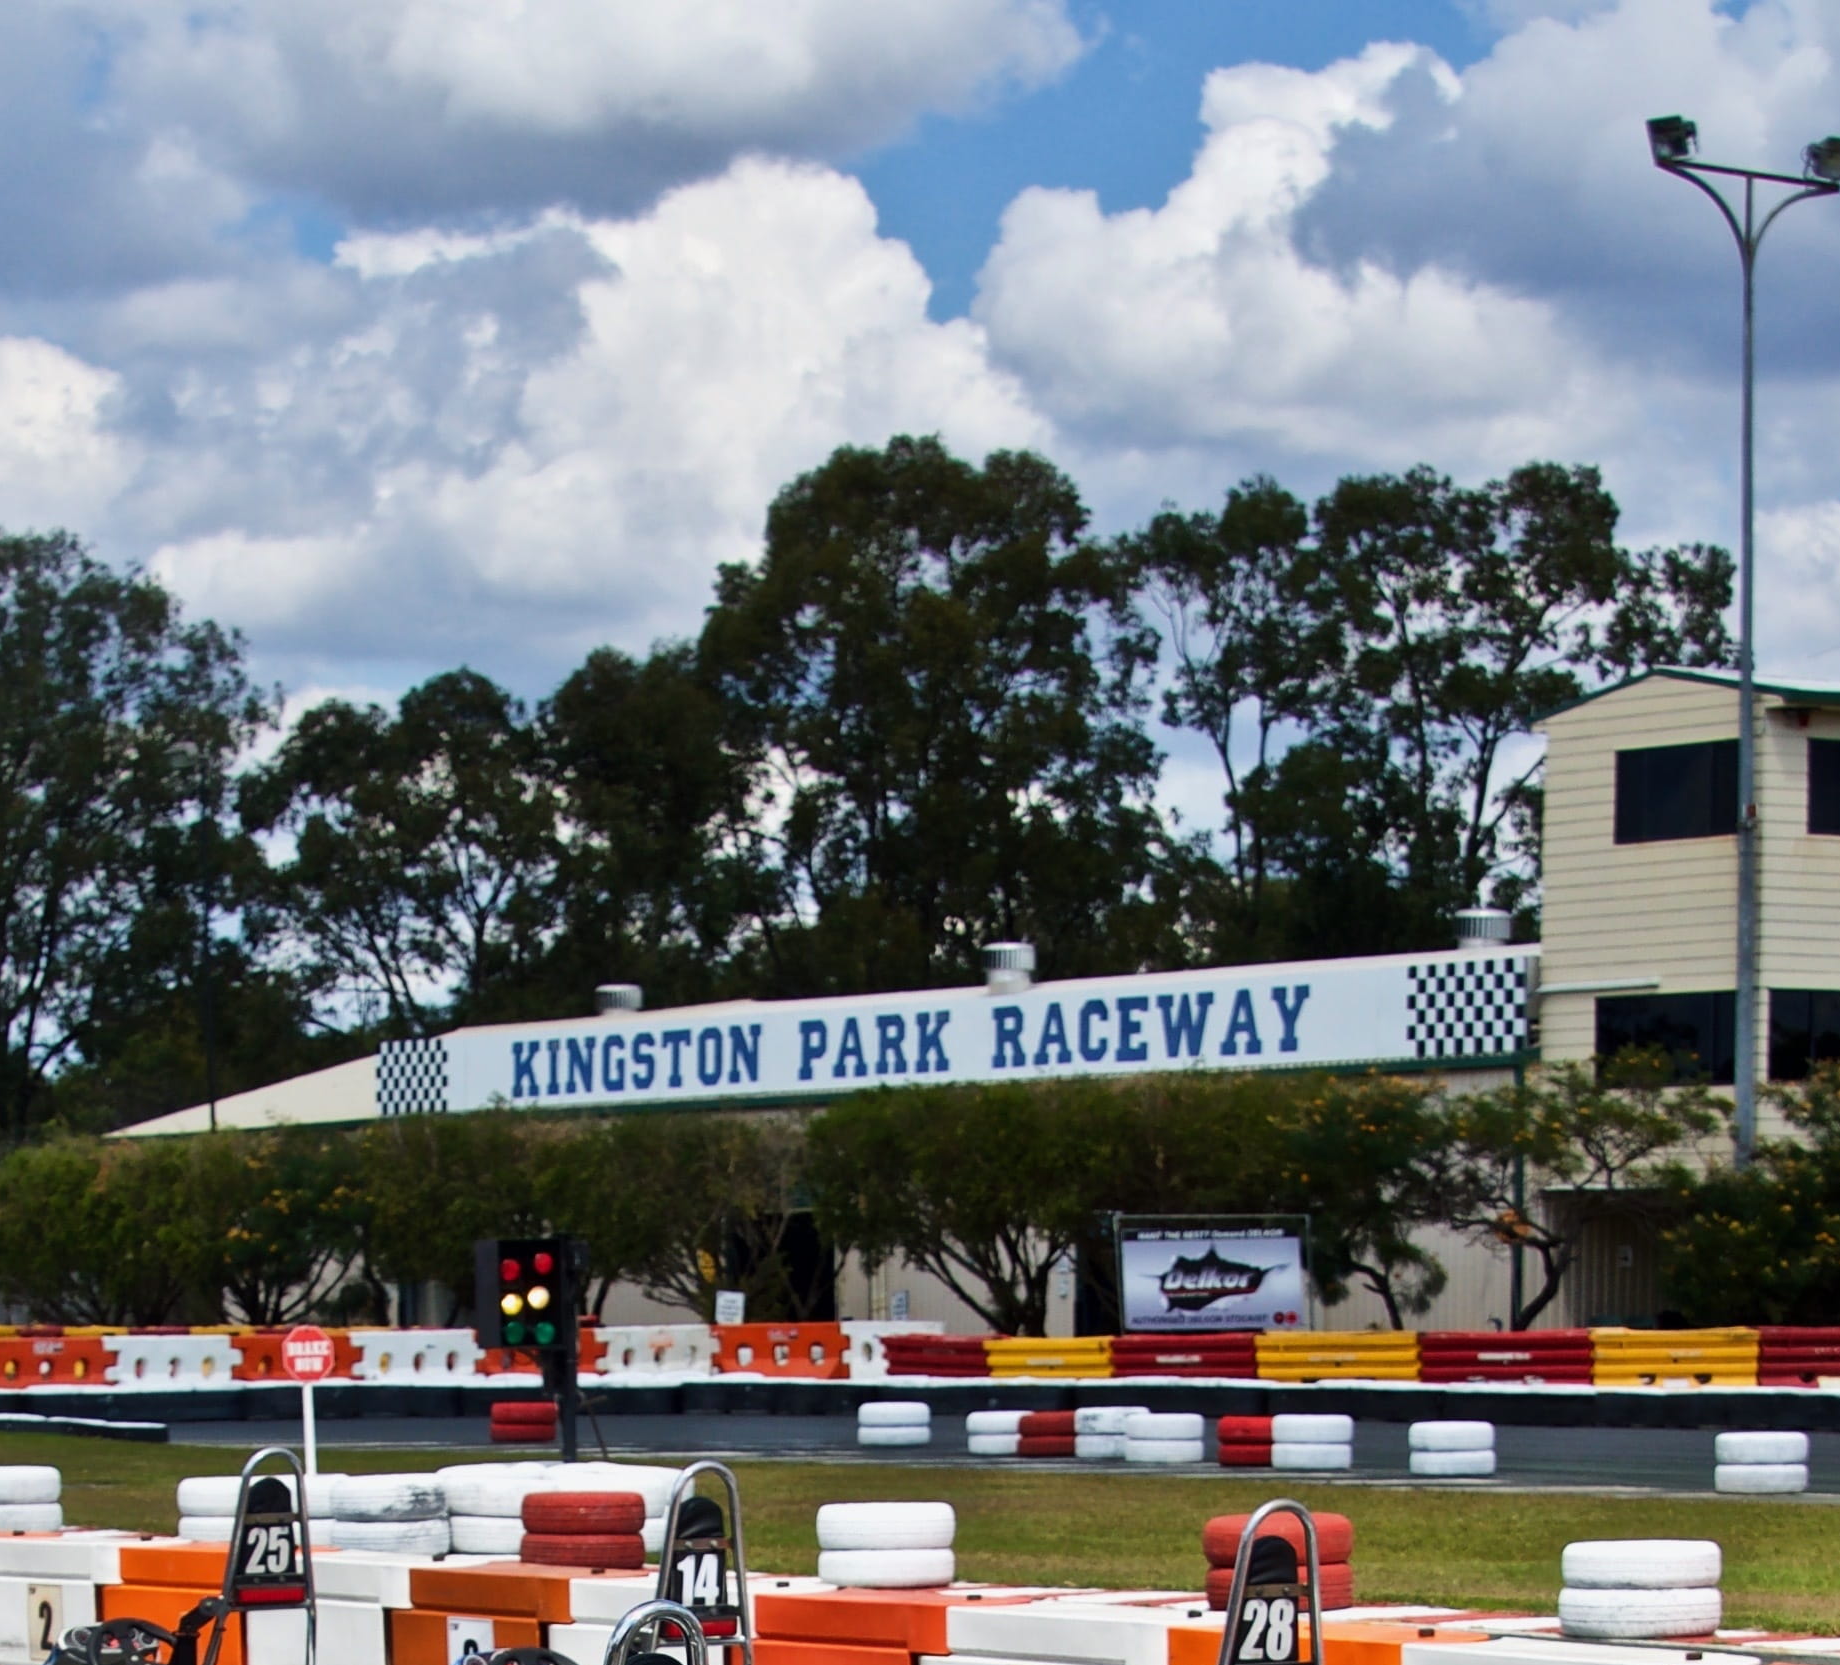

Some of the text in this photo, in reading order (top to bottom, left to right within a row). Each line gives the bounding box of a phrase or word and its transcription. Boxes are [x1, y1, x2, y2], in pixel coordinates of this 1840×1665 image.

[511, 984, 1311, 1098] KINGSTON PARK RACEWAY
[1163, 1268, 1251, 1290] Delkor
[246, 1525, 290, 1574] 25
[677, 1553, 719, 1606] 14
[38, 1600, 54, 1651] 2
[1239, 1598, 1295, 1661] 28
